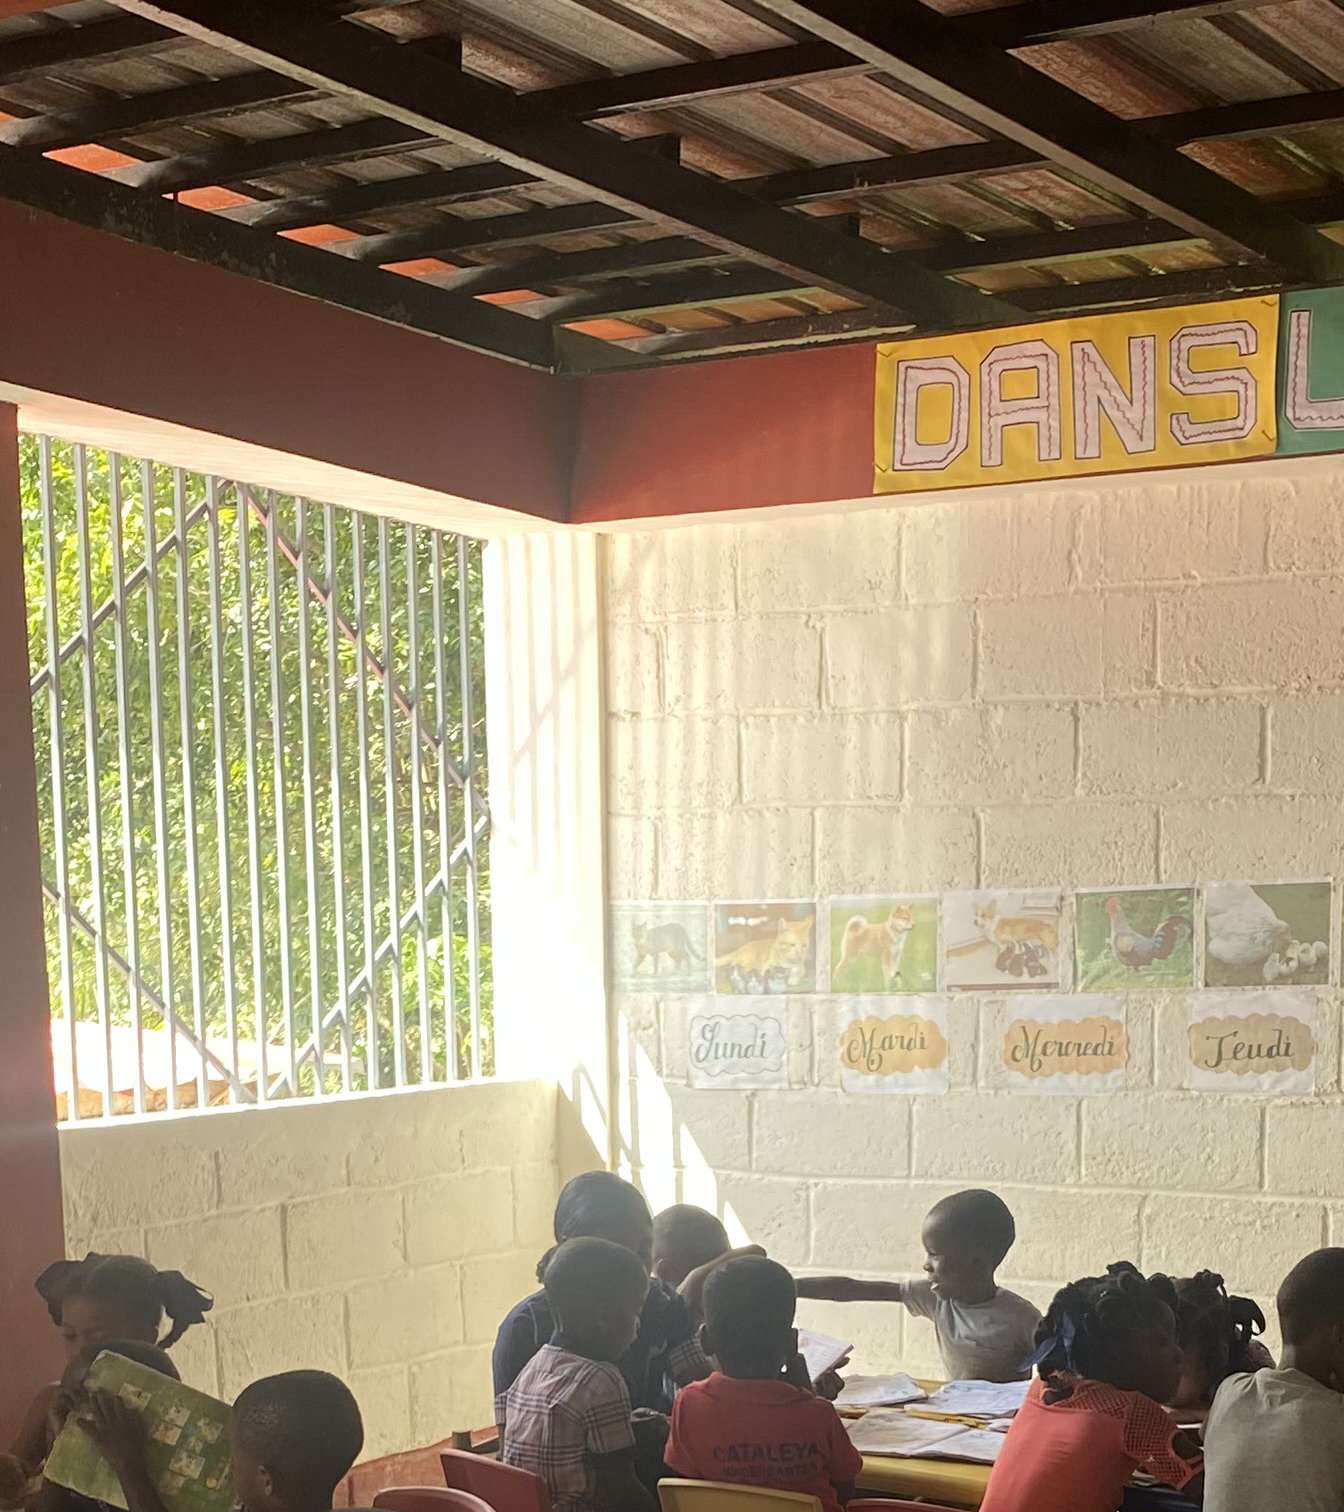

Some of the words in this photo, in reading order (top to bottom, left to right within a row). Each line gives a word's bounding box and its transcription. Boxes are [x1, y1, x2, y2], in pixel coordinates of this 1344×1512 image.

[892, 319, 1259, 471] DANS
[847, 1022, 929, 1073] Mardi
[1010, 1024, 1116, 1073] Mercredi
[1204, 1028, 1294, 1069] Jeudi
[712, 1441, 826, 1464] CATALEYA
